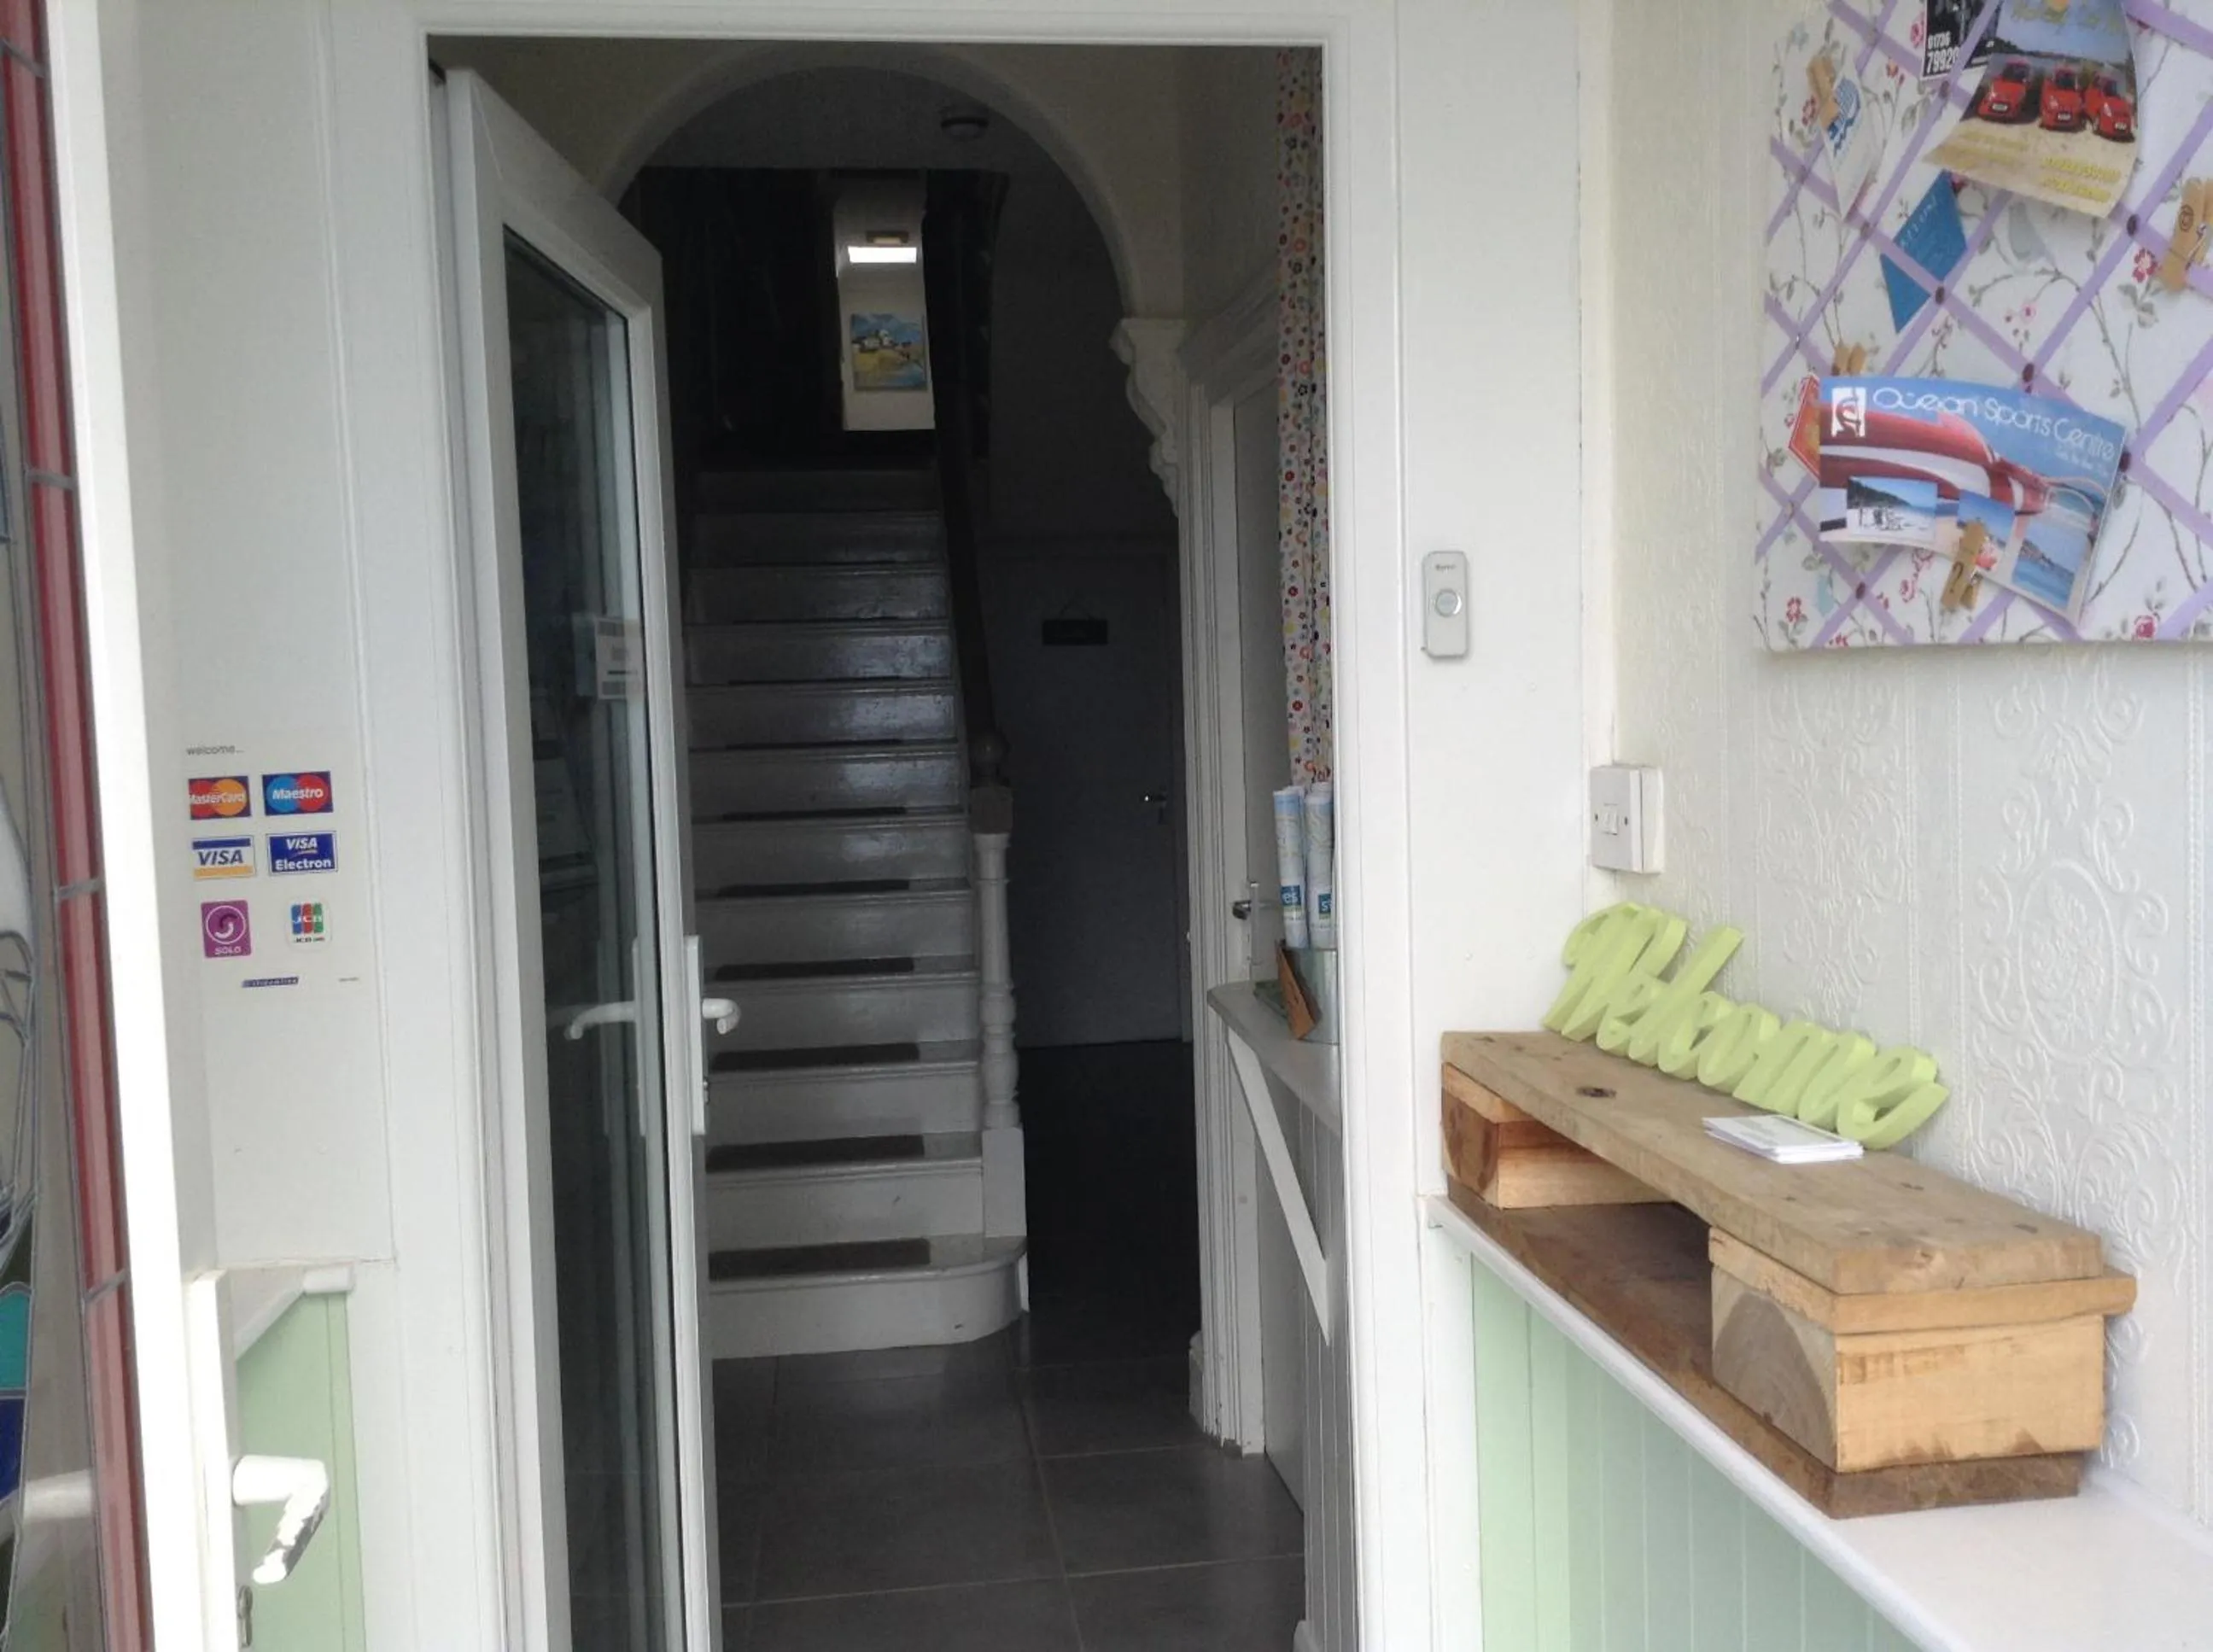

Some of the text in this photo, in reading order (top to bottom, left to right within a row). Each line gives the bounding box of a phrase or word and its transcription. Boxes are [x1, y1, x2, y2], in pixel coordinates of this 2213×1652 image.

[1872, 387, 1979, 417] Ocean
[1983, 396, 2052, 438] Sports
[2053, 417, 2116, 461] Centre
[272, 787, 324, 800] Maestro
[286, 837, 318, 850] VISA
[197, 849, 243, 866] VISA
[275, 858, 331, 871] Electron
[214, 945, 242, 954] SOLO
